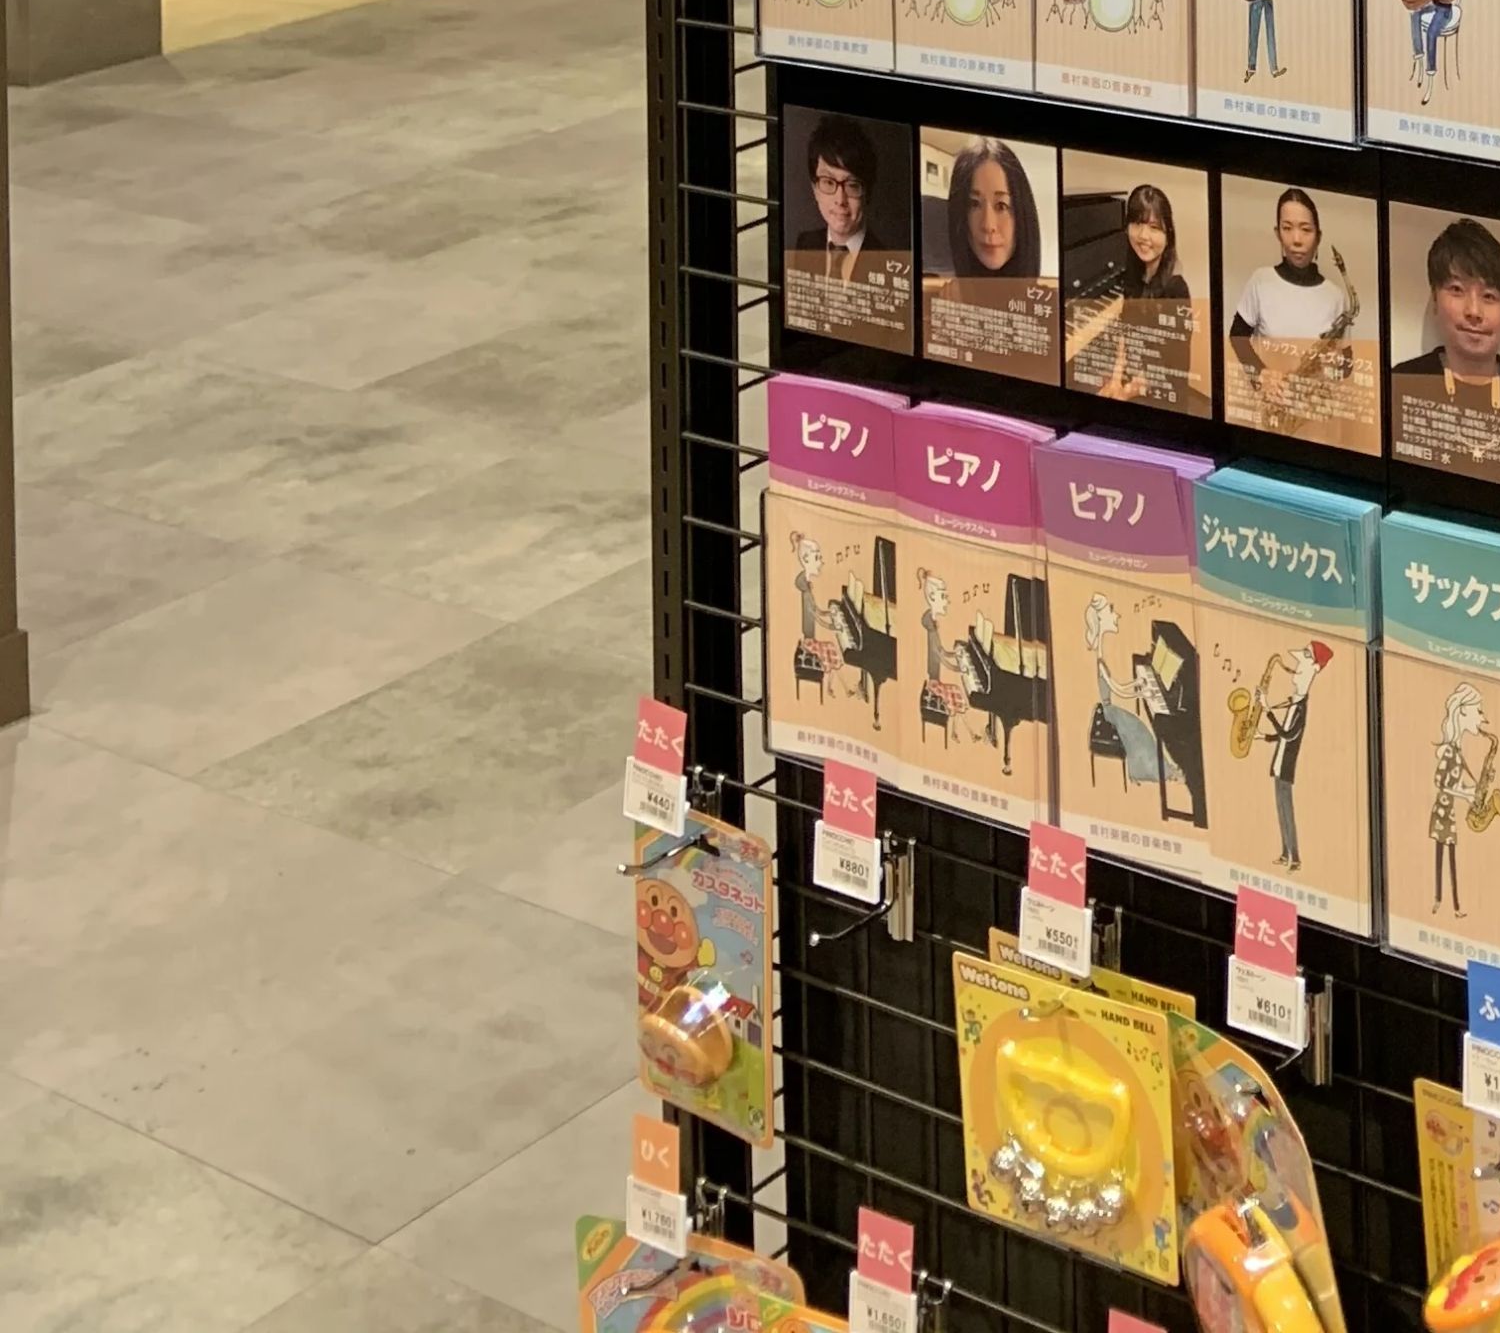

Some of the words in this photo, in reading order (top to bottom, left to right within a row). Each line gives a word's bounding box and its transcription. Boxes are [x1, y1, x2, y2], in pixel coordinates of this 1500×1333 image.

[1026, 286, 1053, 301] ピアノ
[801, 412, 868, 457] ピアノ
[926, 445, 1001, 492] ピアノ
[1069, 481, 1144, 526] ピアノ
[1201, 513, 1342, 584] ジャズサックス
[637, 719, 684, 757] たたく
[825, 780, 874, 818] たたく
[839, 857, 865, 875] ¥880
[1030, 845, 1085, 885] たたく
[1045, 926, 1073, 946] ¥550
[1237, 911, 1295, 954] たたく
[959, 962, 1030, 1001] Weltone
[1131, 990, 1158, 1007] HAND
[1101, 1009, 1130, 1027] HAND
[1133, 1019, 1156, 1035] BELL
[1256, 997, 1286, 1018] ¥610
[639, 1139, 670, 1168] ひく
[859, 1232, 911, 1272] たたく
